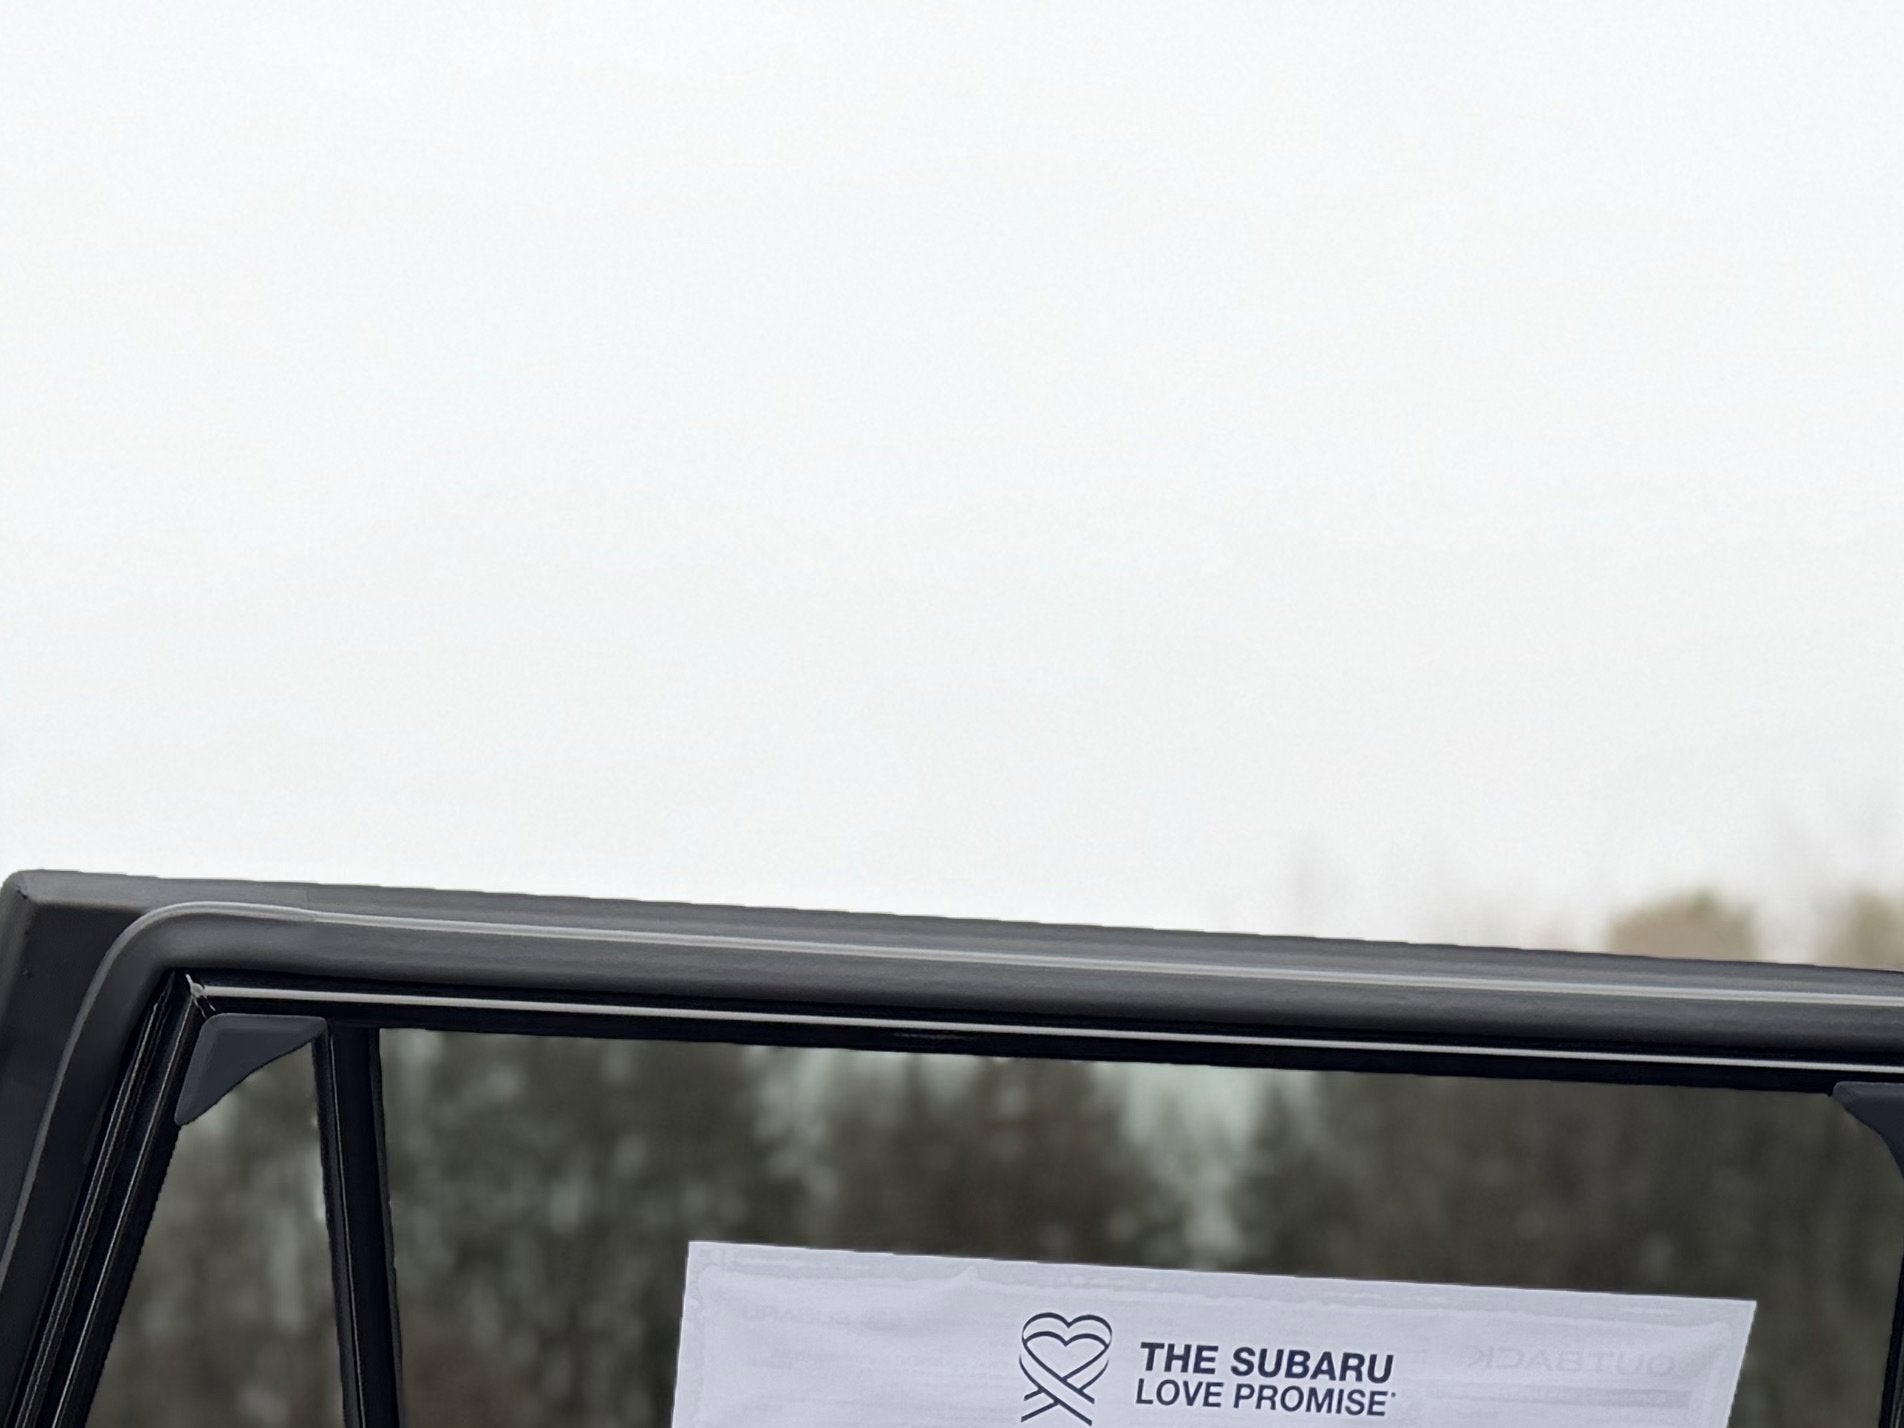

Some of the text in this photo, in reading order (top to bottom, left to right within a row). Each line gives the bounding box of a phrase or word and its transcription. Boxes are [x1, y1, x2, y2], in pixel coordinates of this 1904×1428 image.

[1140, 1341, 1394, 1384] THE SUBARU
[1135, 1377, 1225, 1408] LOVE
